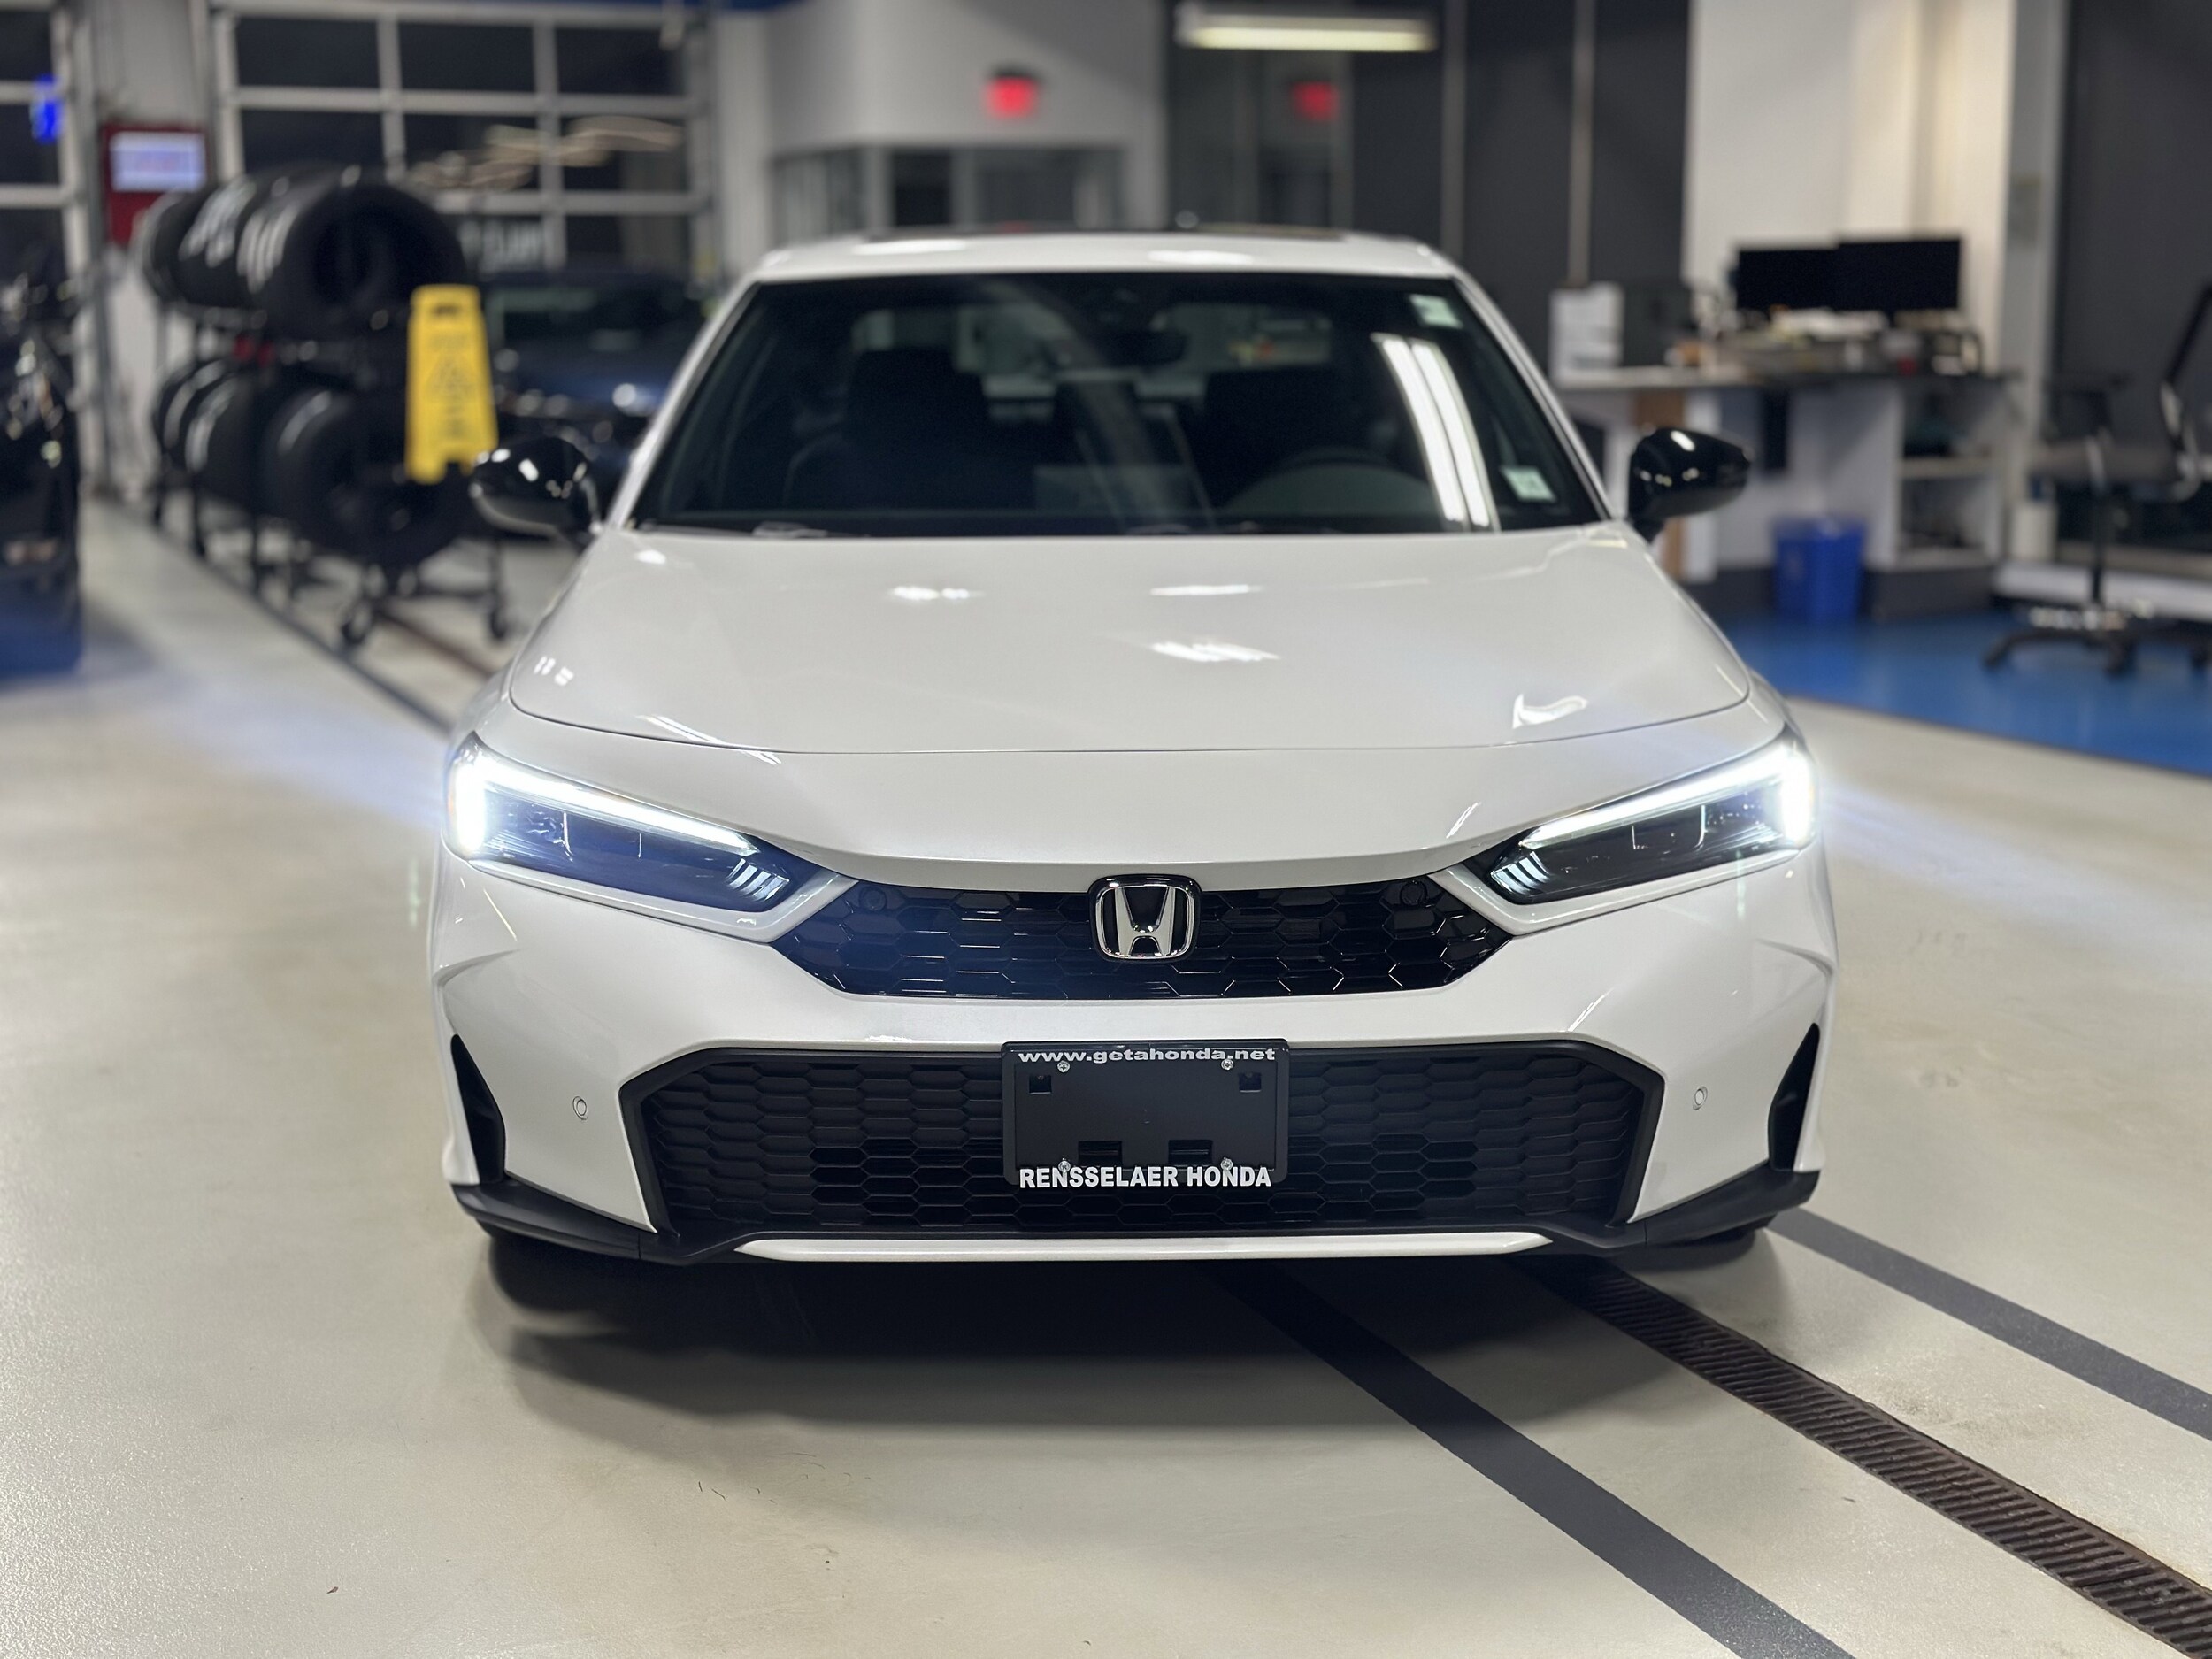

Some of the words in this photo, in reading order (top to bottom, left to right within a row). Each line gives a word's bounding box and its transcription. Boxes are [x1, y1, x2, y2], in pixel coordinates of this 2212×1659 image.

[1018, 1048, 1276, 1064] www.getahonda.net
[1019, 1166, 1179, 1188] RENSSELAER
[1187, 1166, 1271, 1187] HONDA
